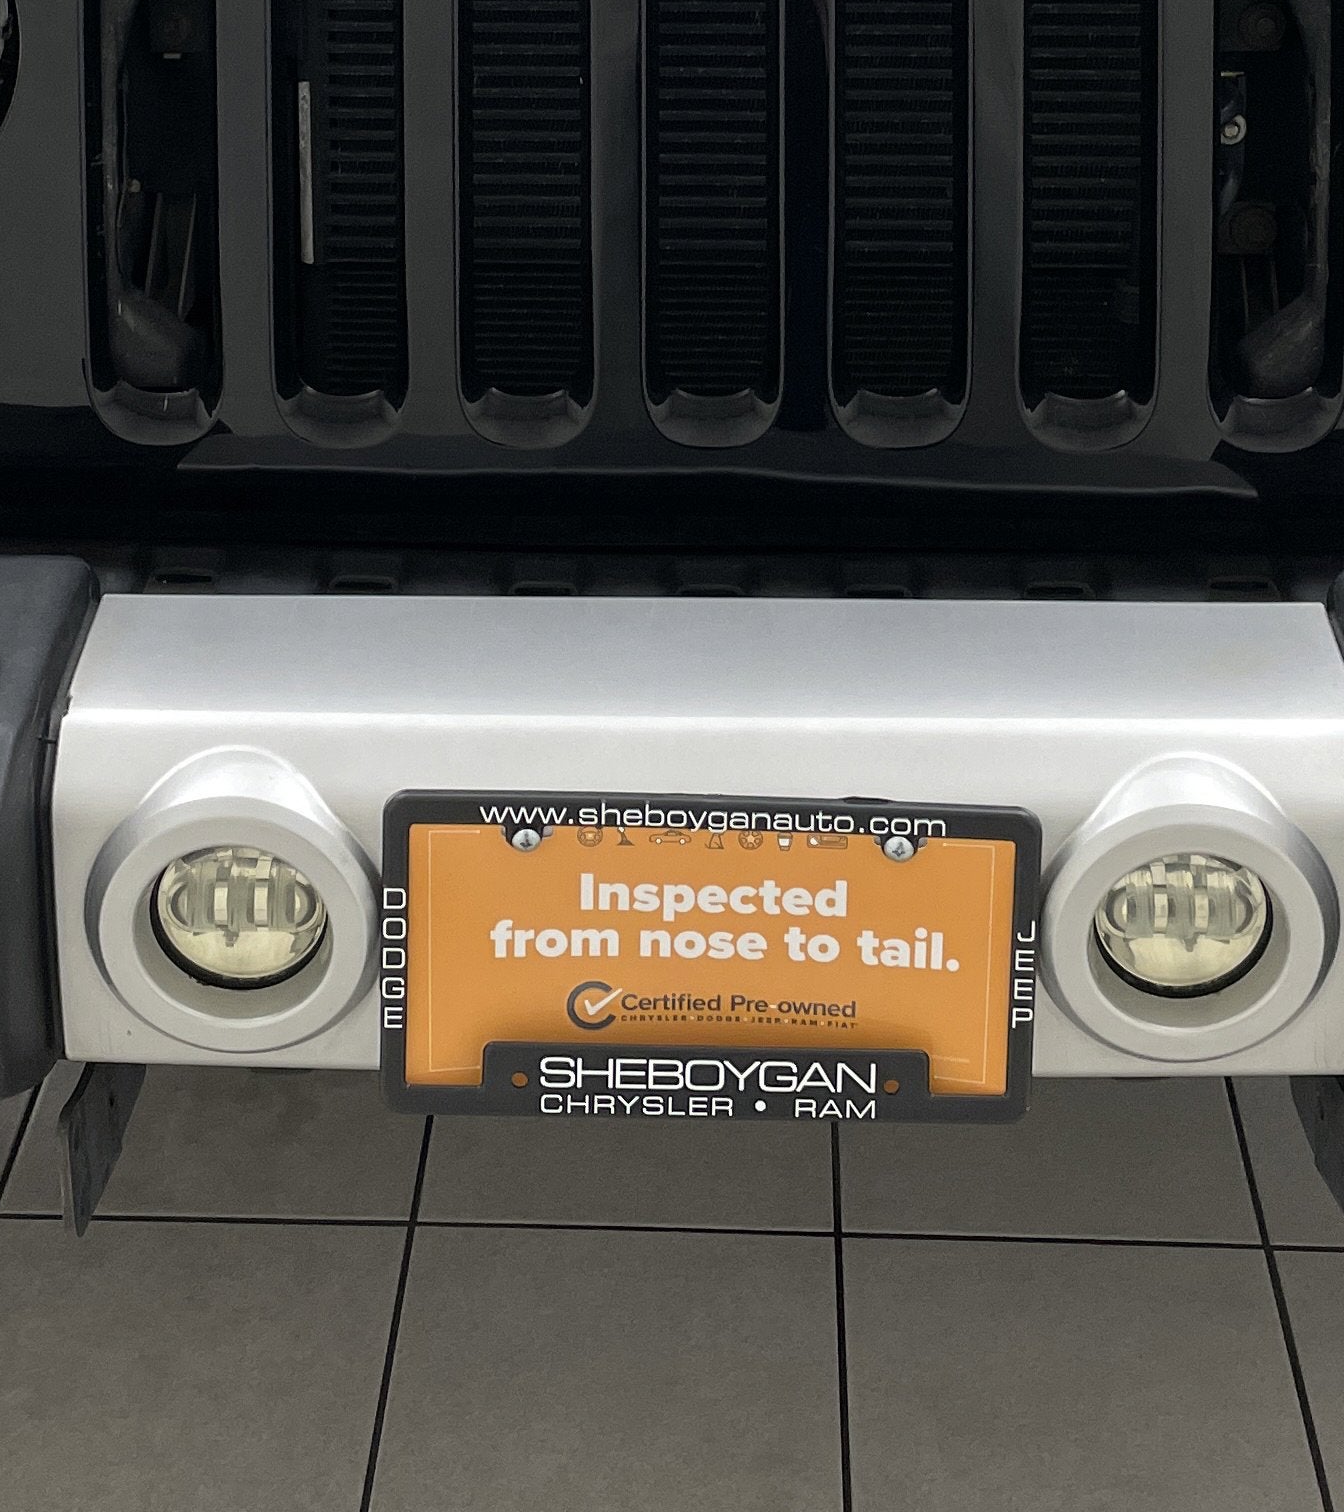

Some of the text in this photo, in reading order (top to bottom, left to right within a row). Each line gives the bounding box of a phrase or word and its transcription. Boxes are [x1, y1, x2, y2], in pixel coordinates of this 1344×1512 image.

[479, 801, 947, 837] www.sheboyganauto.com
[580, 872, 848, 922] Inspected
[381, 887, 407, 1029] DODGE
[490, 919, 960, 972] from nose to tail.
[1011, 920, 1036, 1029] JEEP
[621, 992, 857, 1018] Certified Pre-owned
[539, 1056, 877, 1095] SHEBOYGAN
[540, 1093, 877, 1120] CHRYSLER RAM
